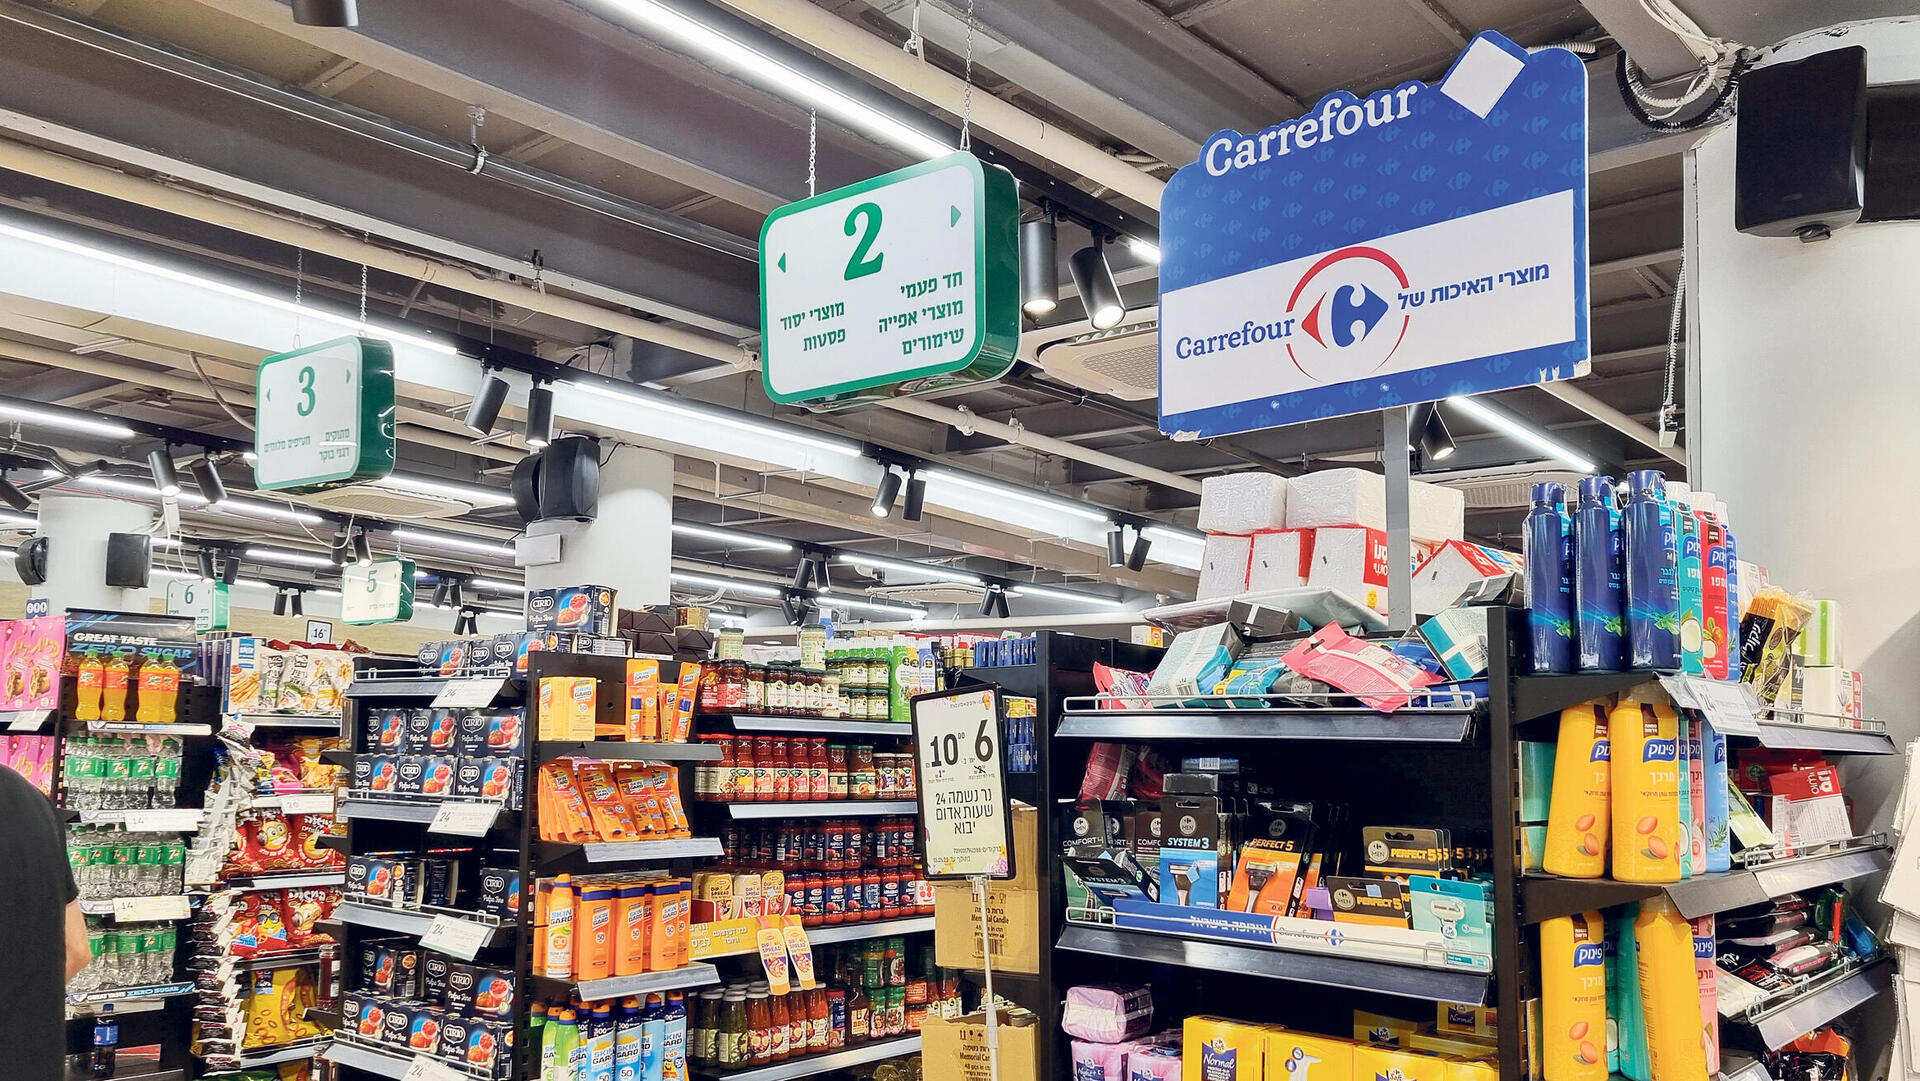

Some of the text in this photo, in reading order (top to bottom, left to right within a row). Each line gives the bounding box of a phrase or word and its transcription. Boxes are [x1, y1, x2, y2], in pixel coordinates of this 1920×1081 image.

[1205, 82, 1419, 177] Carrefour
[844, 202, 884, 281] 2
[900, 271, 963, 299] חד פעמי
[1398, 263, 1550, 311] מוצרי האיכות של
[780, 301, 845, 331] מוצרי יסוד
[878, 299, 963, 333] מוצרי אפייה
[803, 328, 846, 351] פסטות
[902, 327, 965, 355] שימורים
[1175, 315, 1296, 360] Carrefour
[297, 366, 316, 417] 3
[366, 570, 377, 593] 5
[184, 585, 194, 604] 6
[73, 631, 158, 646] GREAT TASTE
[313, 628, 323, 639] 16
[140, 647, 193, 659] SUGAR
[974, 719, 994, 762] 6
[930, 733, 959, 767] 10
[1648, 744, 1675, 759] פינוק
[935, 788, 992, 805] נר נשמה 24
[935, 805, 994, 821] שעות אדום
[954, 820, 976, 835] יבוא
[1063, 837, 1097, 847] COMFORT
[1167, 837, 1209, 849] SYSTEM 3
[1252, 838, 1294, 851] PERFECT 5
[1390, 849, 1437, 861] PERFECT 5
[1357, 896, 1403, 910] PERFECT 5
[550, 915, 573, 925] GARD
[551, 909, 572, 919] SKIN
[592, 916, 609, 926] GARD
[628, 913, 643, 922] GARD
[663, 910, 678, 919] GARD
[632, 930, 640, 938] 50
[666, 926, 674, 934] 50
[1579, 947, 1603, 963] פינוק
[451, 975, 470, 986] CIRIO
[1697, 969, 1714, 979] מרכ
[616, 1049, 639, 1059] GARD
[617, 1042, 638, 1051] SKIN
[1203, 1053, 1235, 1069] Normal
[621, 1069, 633, 1077] 50
